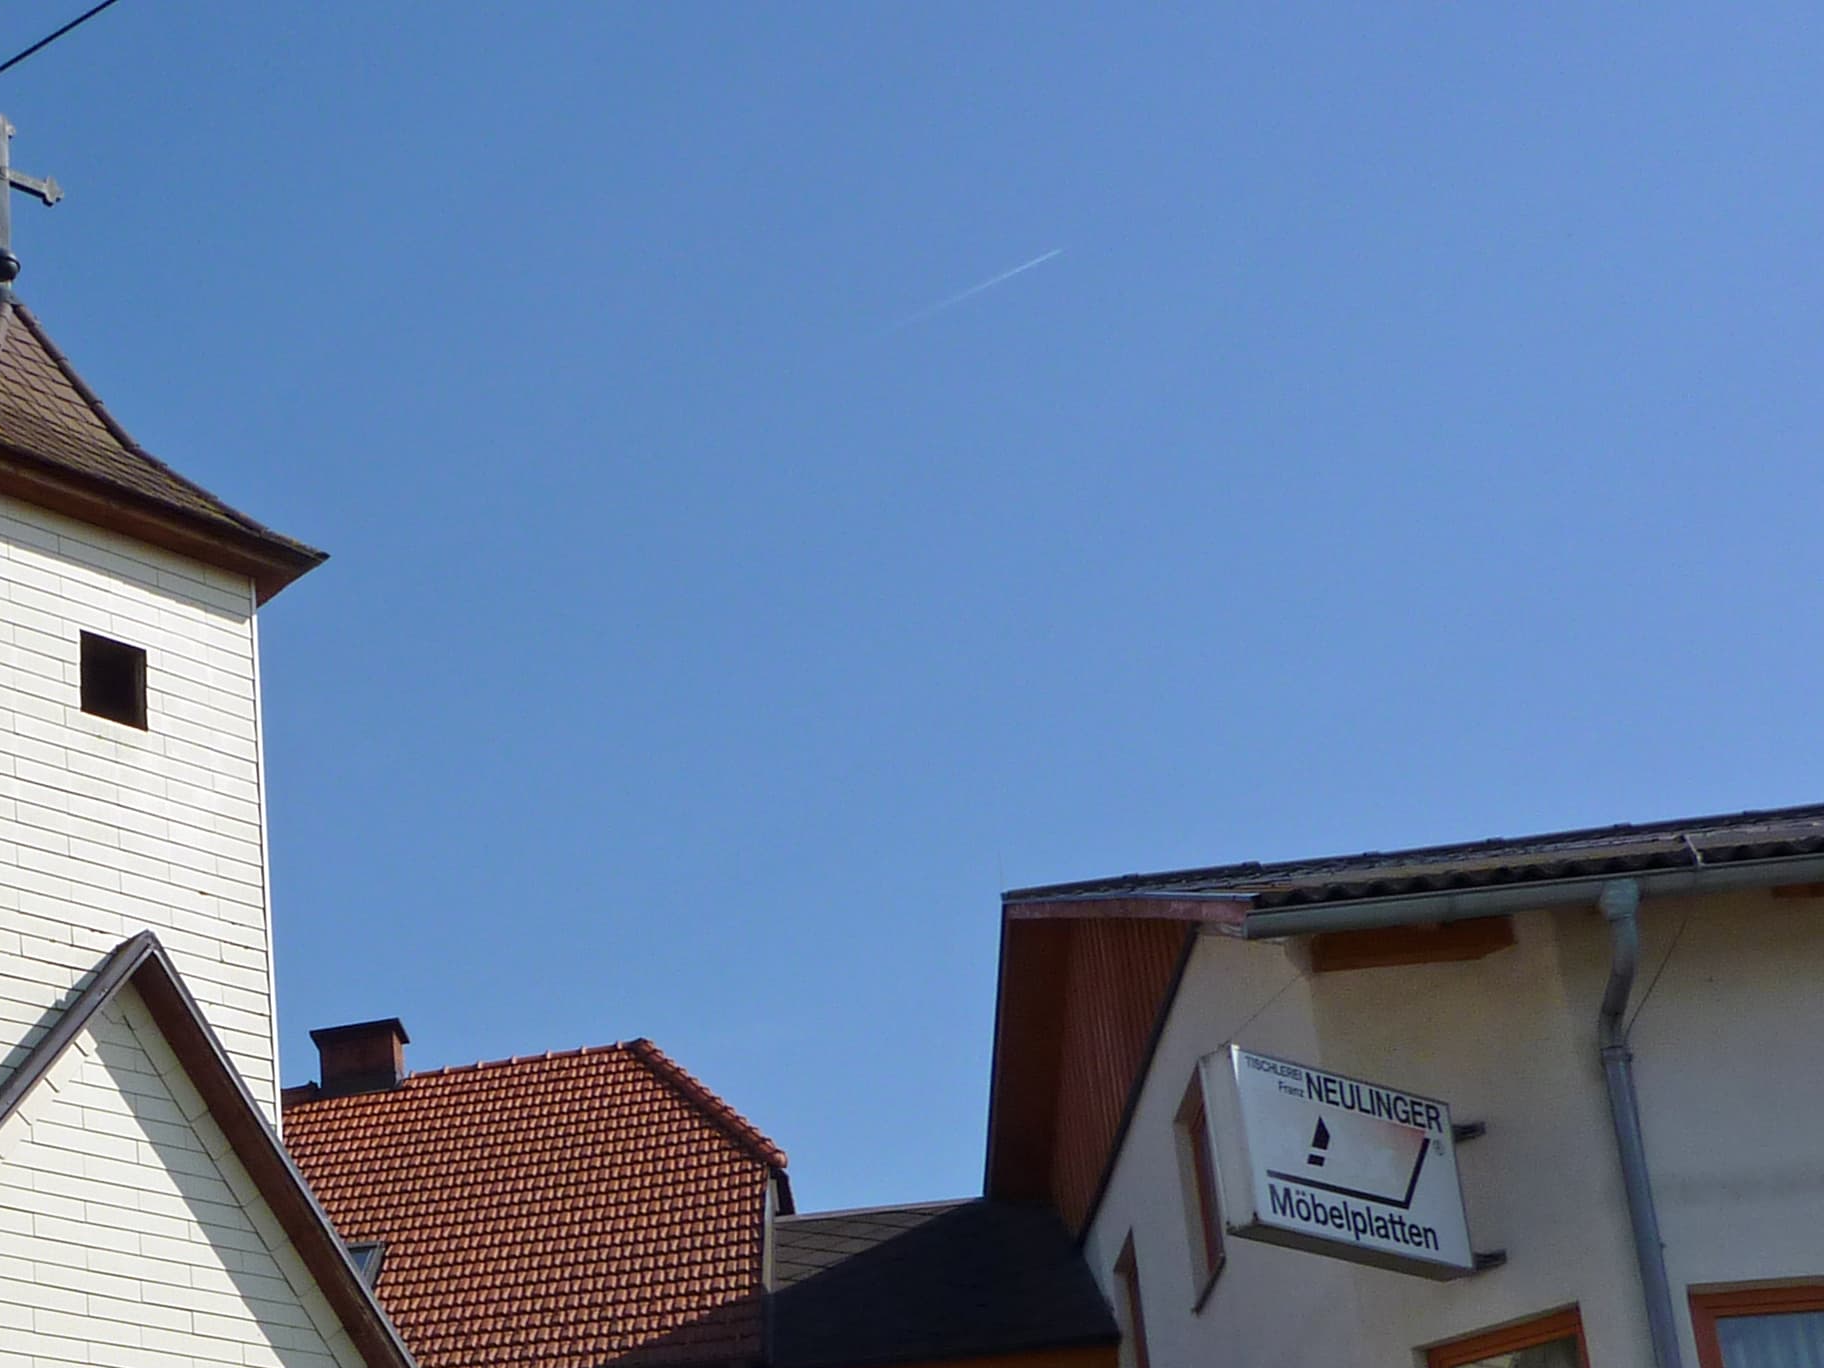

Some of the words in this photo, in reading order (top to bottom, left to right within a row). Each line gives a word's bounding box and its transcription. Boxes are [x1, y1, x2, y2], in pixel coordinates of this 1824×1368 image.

[1245, 1055, 1303, 1081] TISCHLEREI
[1278, 1080, 1305, 1098] Franz
[1305, 1072, 1443, 1133] NEULINGER
[1268, 1183, 1440, 1250] Möbelplatten
